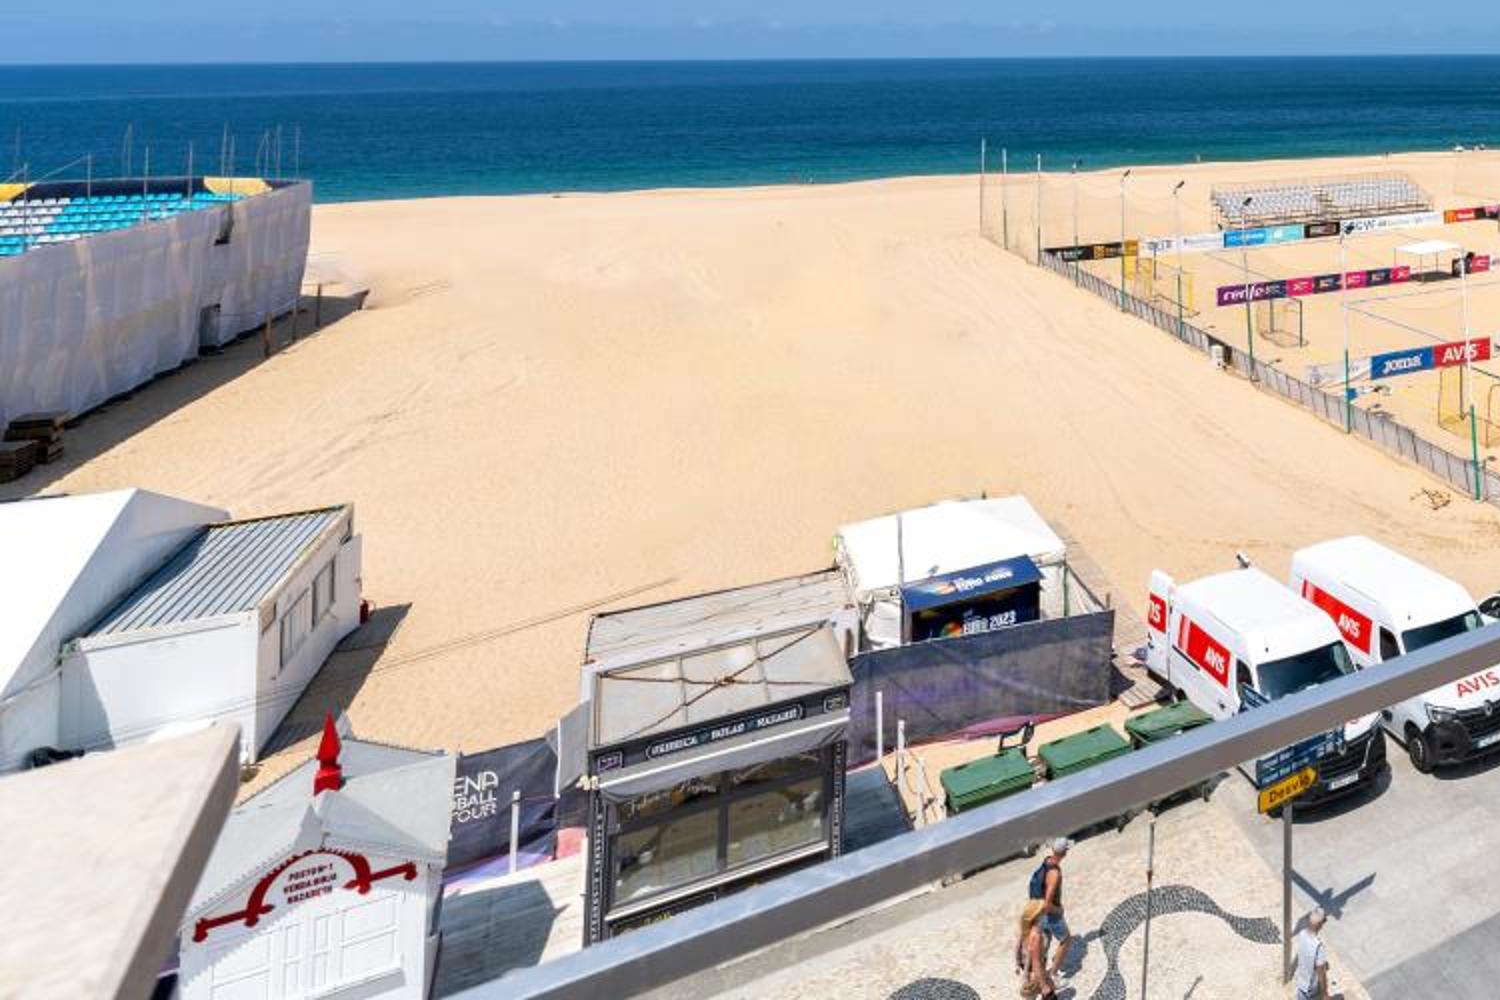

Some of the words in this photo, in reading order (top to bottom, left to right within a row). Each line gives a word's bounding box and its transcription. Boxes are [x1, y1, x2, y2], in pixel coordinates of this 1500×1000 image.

[1442, 343, 1478, 363] AVIS
[989, 609, 1017, 630] 2023
[1338, 612, 1361, 639] AVIS
[1204, 645, 1225, 675] AVIS
[1457, 671, 1500, 697] AVIS
[453, 789, 497, 811] BALL
[1268, 773, 1312, 803] Desvio
